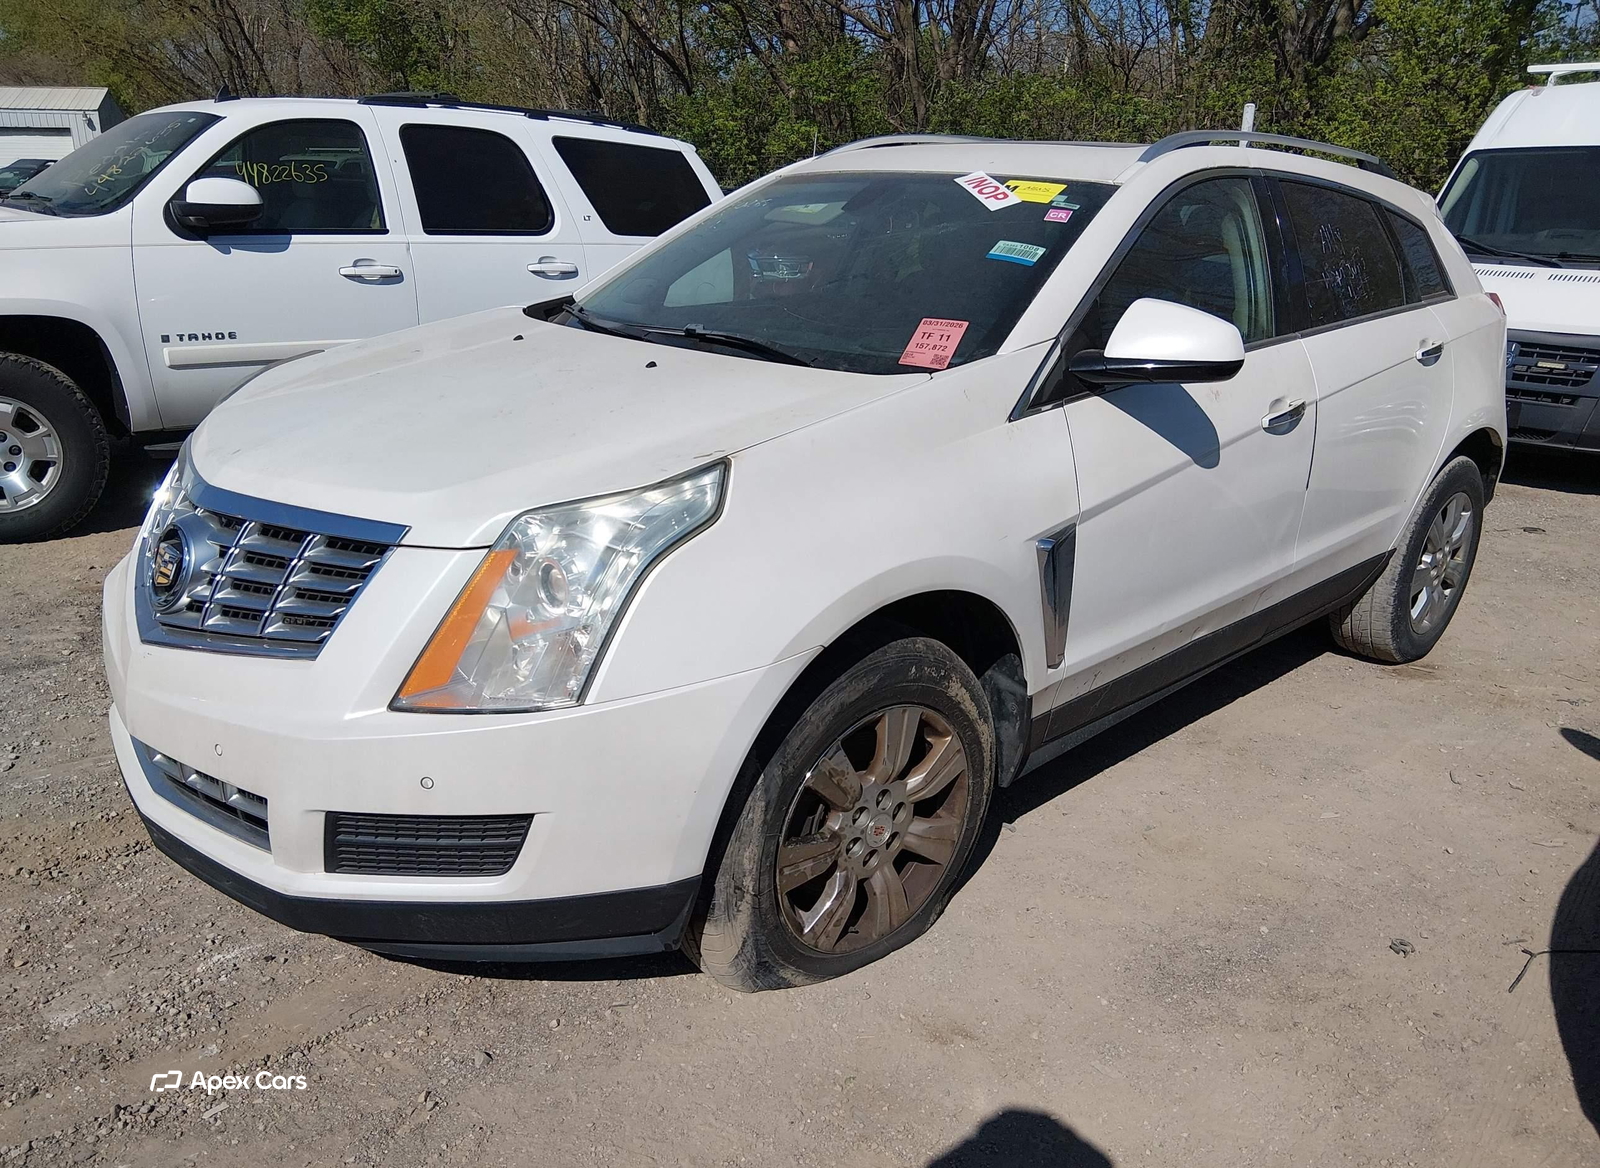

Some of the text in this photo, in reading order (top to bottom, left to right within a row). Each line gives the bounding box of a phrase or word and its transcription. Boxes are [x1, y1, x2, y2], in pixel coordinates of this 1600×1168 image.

[235, 161, 329, 187] 44822635
[964, 176, 1010, 201] INOP
[922, 319, 964, 329] 03/31/2026
[176, 331, 238, 342] TAHOE
[920, 331, 951, 342] TF 11
[914, 342, 948, 352] 157,872
